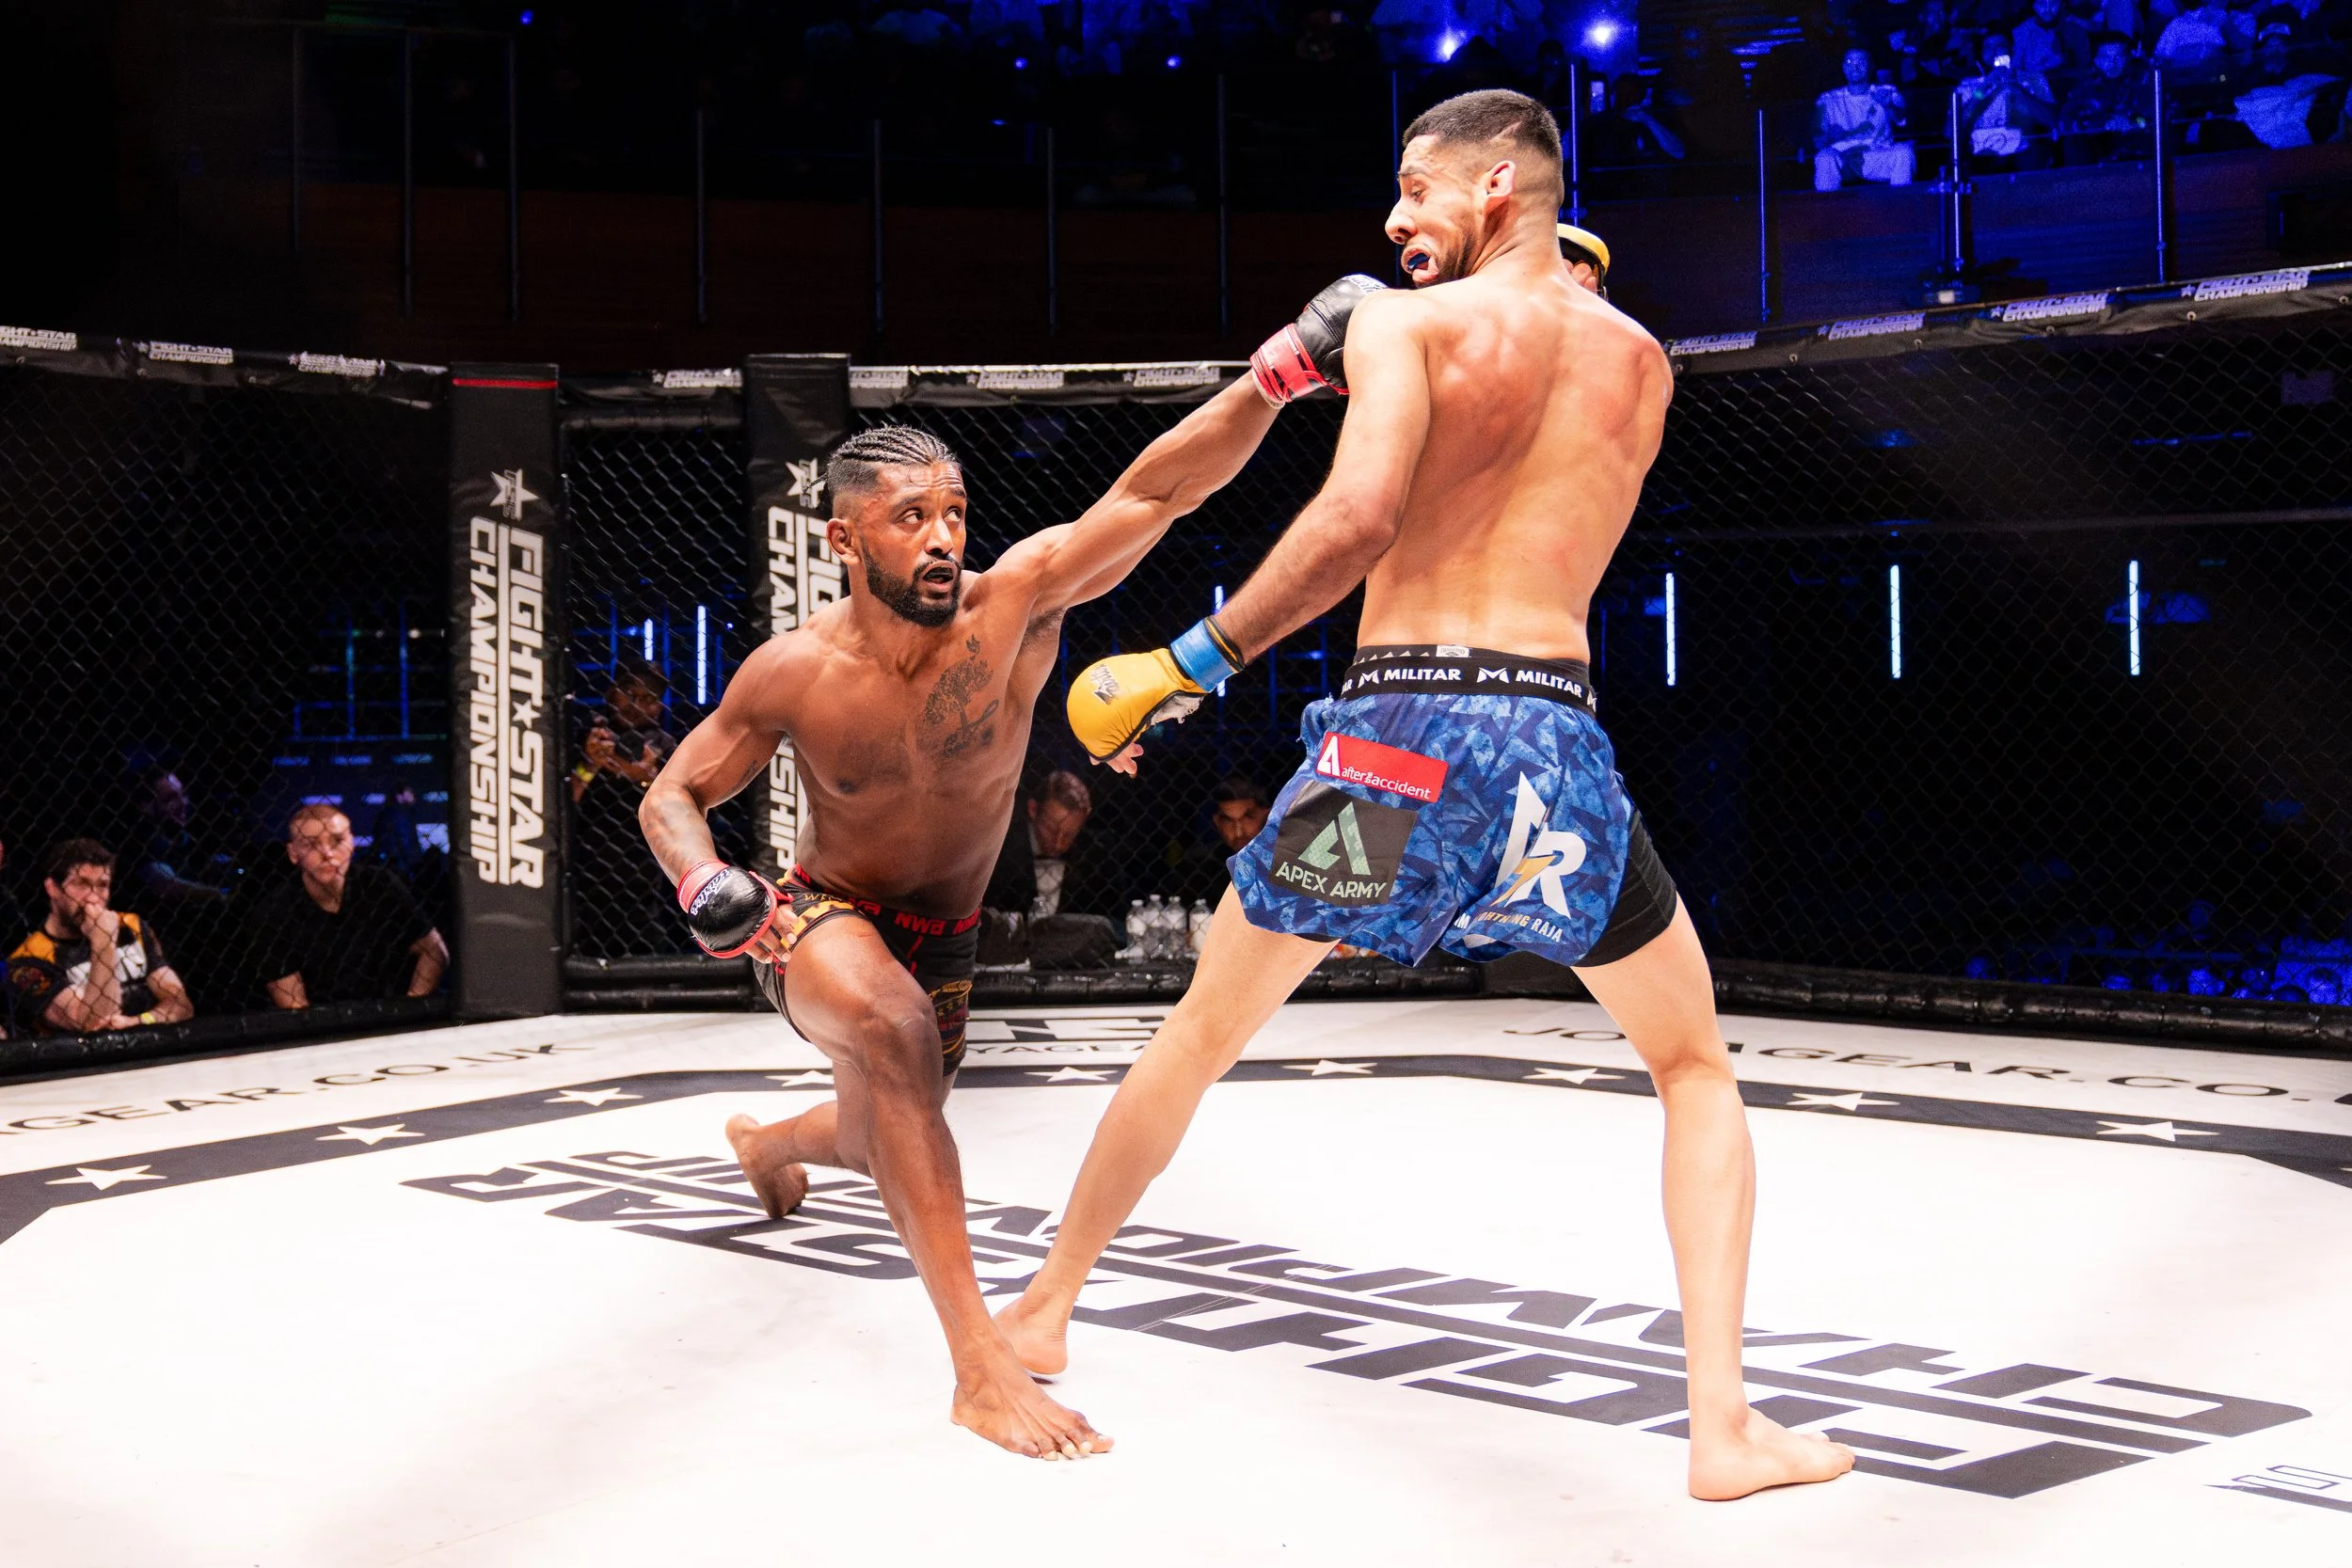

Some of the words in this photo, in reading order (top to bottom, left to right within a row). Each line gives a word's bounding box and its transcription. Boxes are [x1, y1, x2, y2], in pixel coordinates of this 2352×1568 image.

[509, 528, 544, 707] FIGHT
[469, 516, 498, 883] CHAMPIONSHIP
[1383, 669, 1461, 681] MILITAR
[1515, 670, 1582, 699] MILITAR
[509, 722, 544, 889] STAR
[1371, 775, 1431, 800] accident
[1275, 861, 1328, 894] APEX
[1329, 880, 1387, 899] ARMY
[1531, 918, 1564, 942] RAJA
